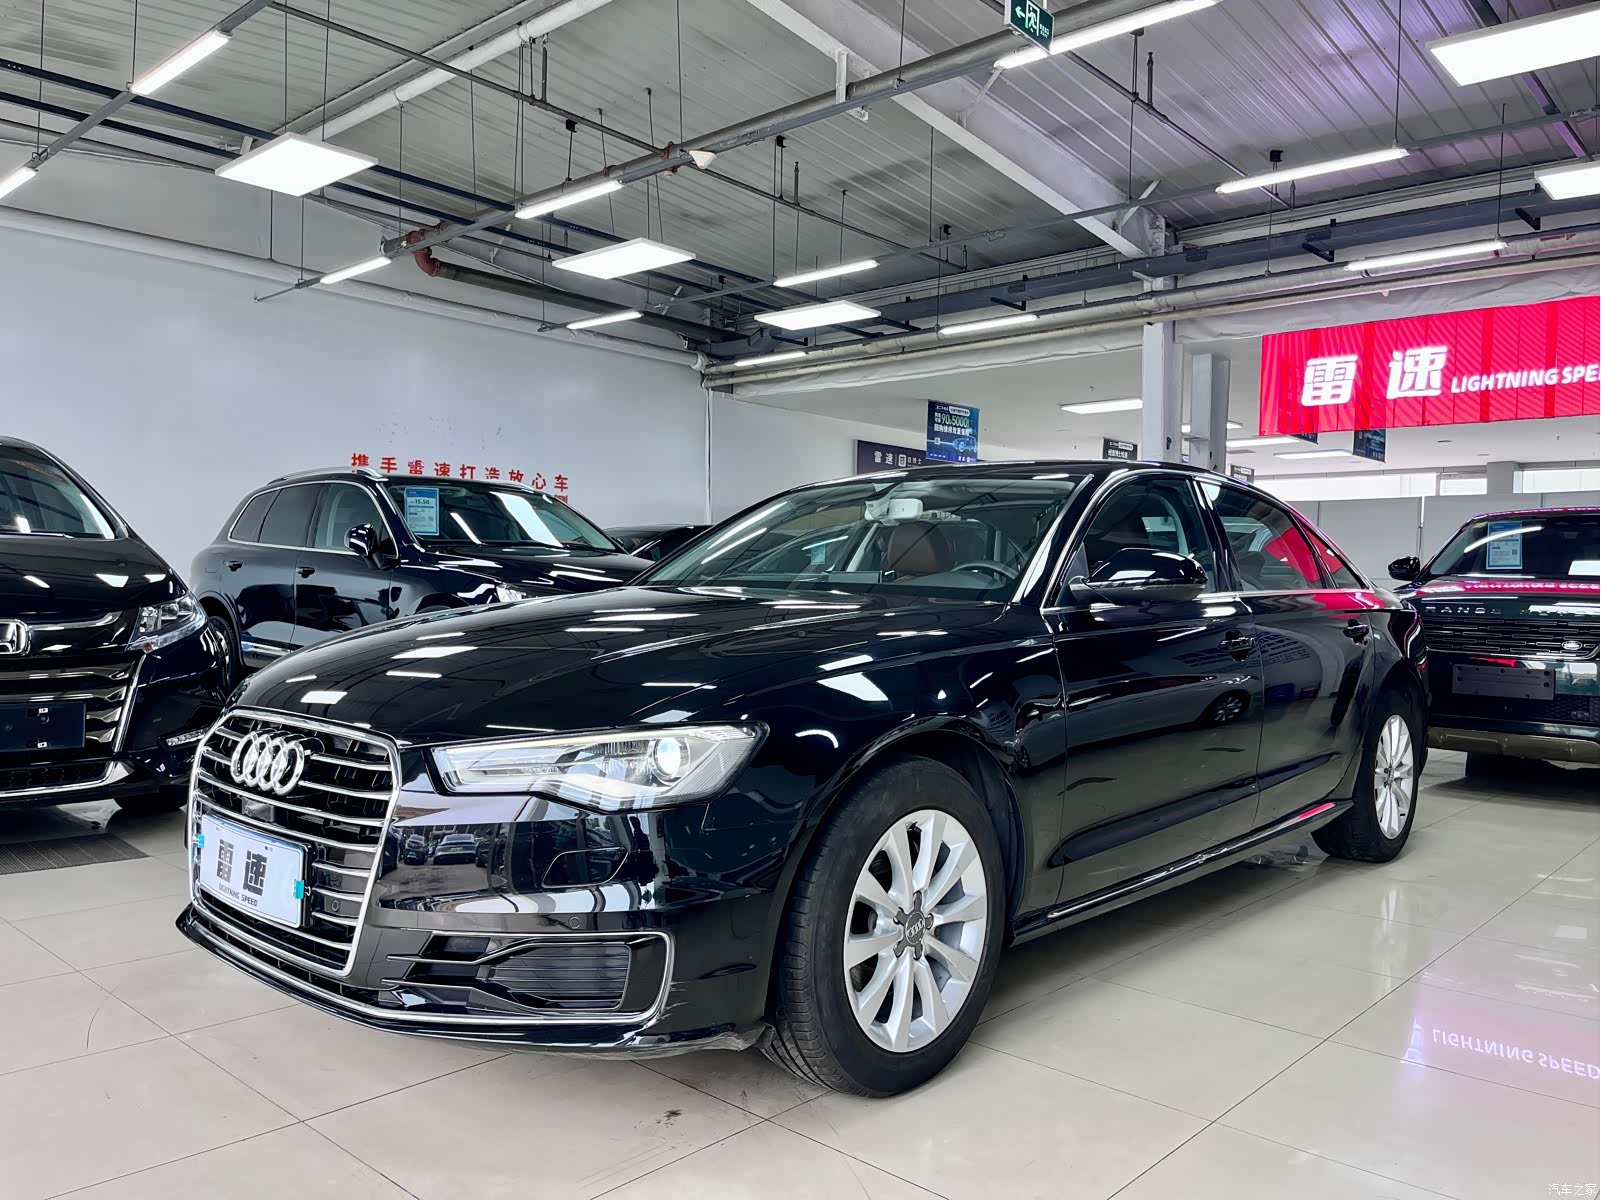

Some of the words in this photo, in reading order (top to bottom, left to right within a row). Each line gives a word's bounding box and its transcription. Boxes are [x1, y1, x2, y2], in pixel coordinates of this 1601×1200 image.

[1301, 346, 1448, 407] 雷速
[1451, 368, 1558, 394] LIGHTNING
[1561, 364, 1600, 385] SPE
[217, 839, 267, 896] 雷速
[241, 895, 258, 907] SPEED
